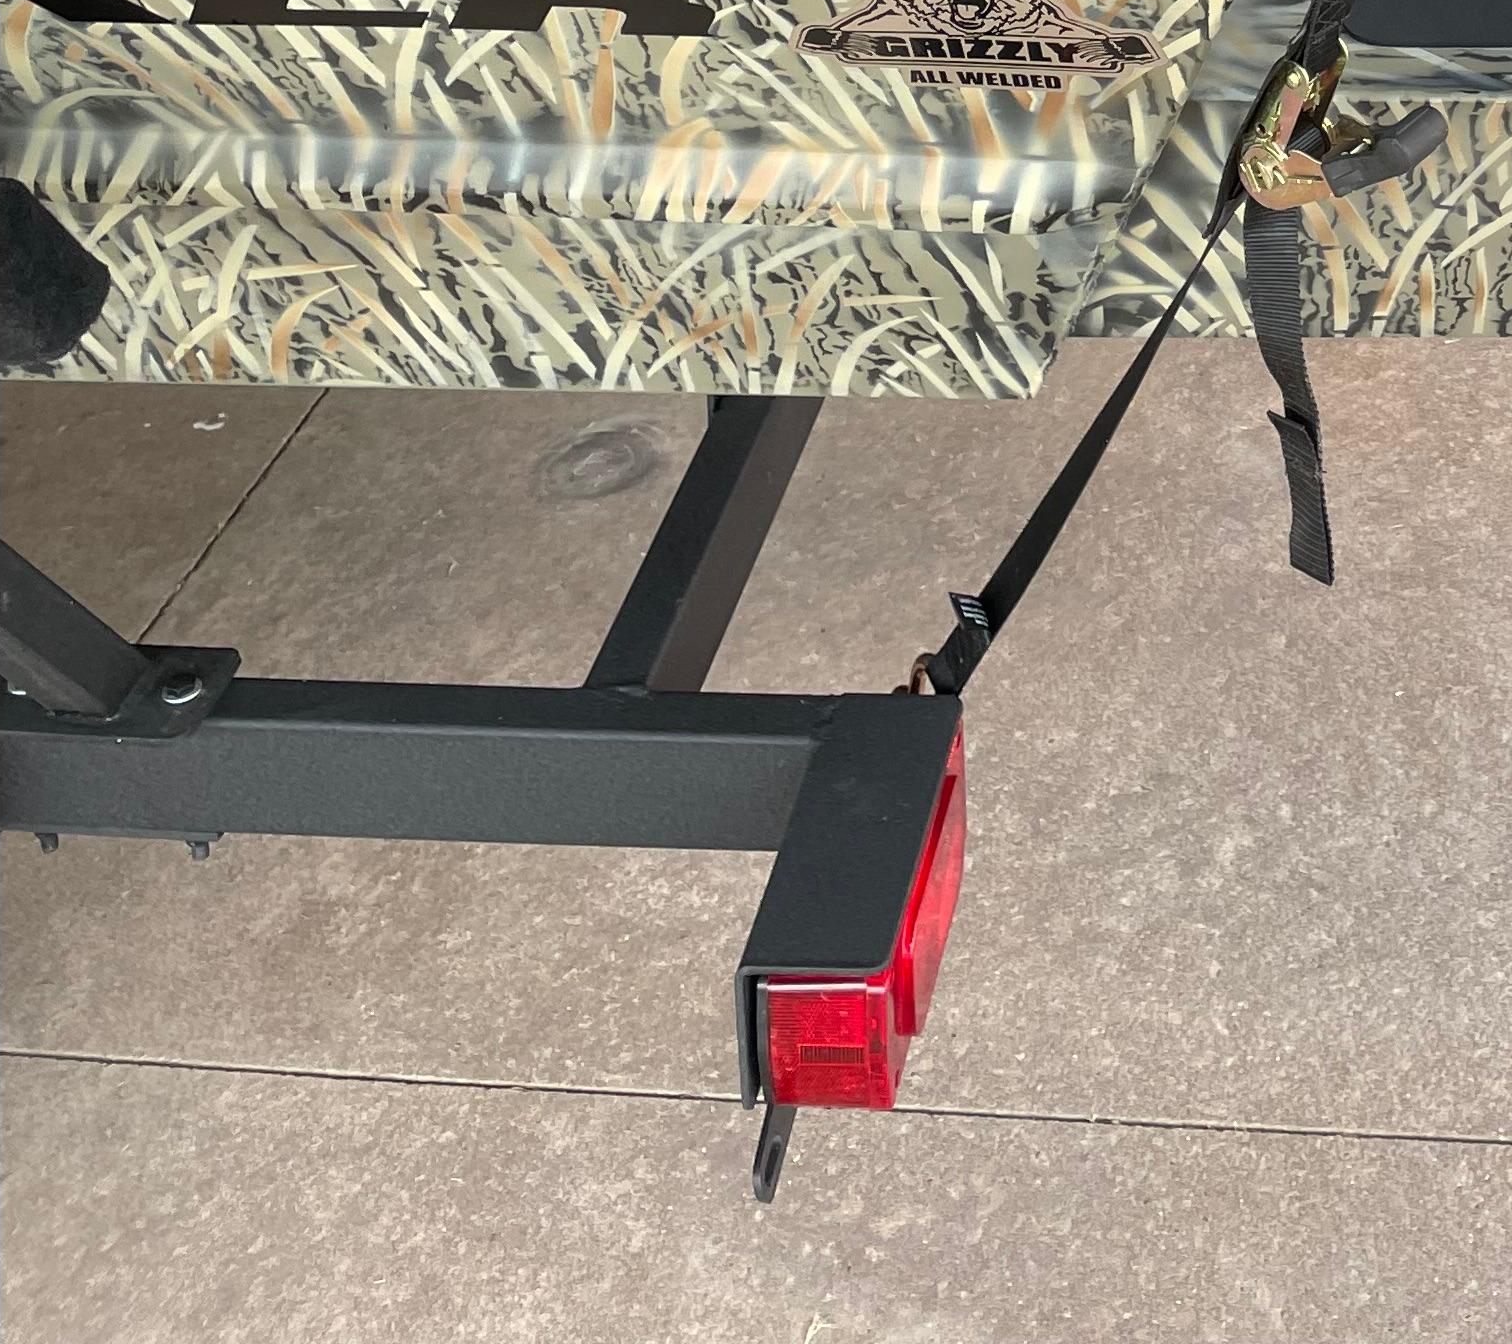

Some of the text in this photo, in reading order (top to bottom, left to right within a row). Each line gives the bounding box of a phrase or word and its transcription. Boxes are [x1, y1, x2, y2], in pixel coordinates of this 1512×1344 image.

[875, 35, 1081, 64] GRIZZLY
[910, 70, 1062, 89] ALL WELDED
